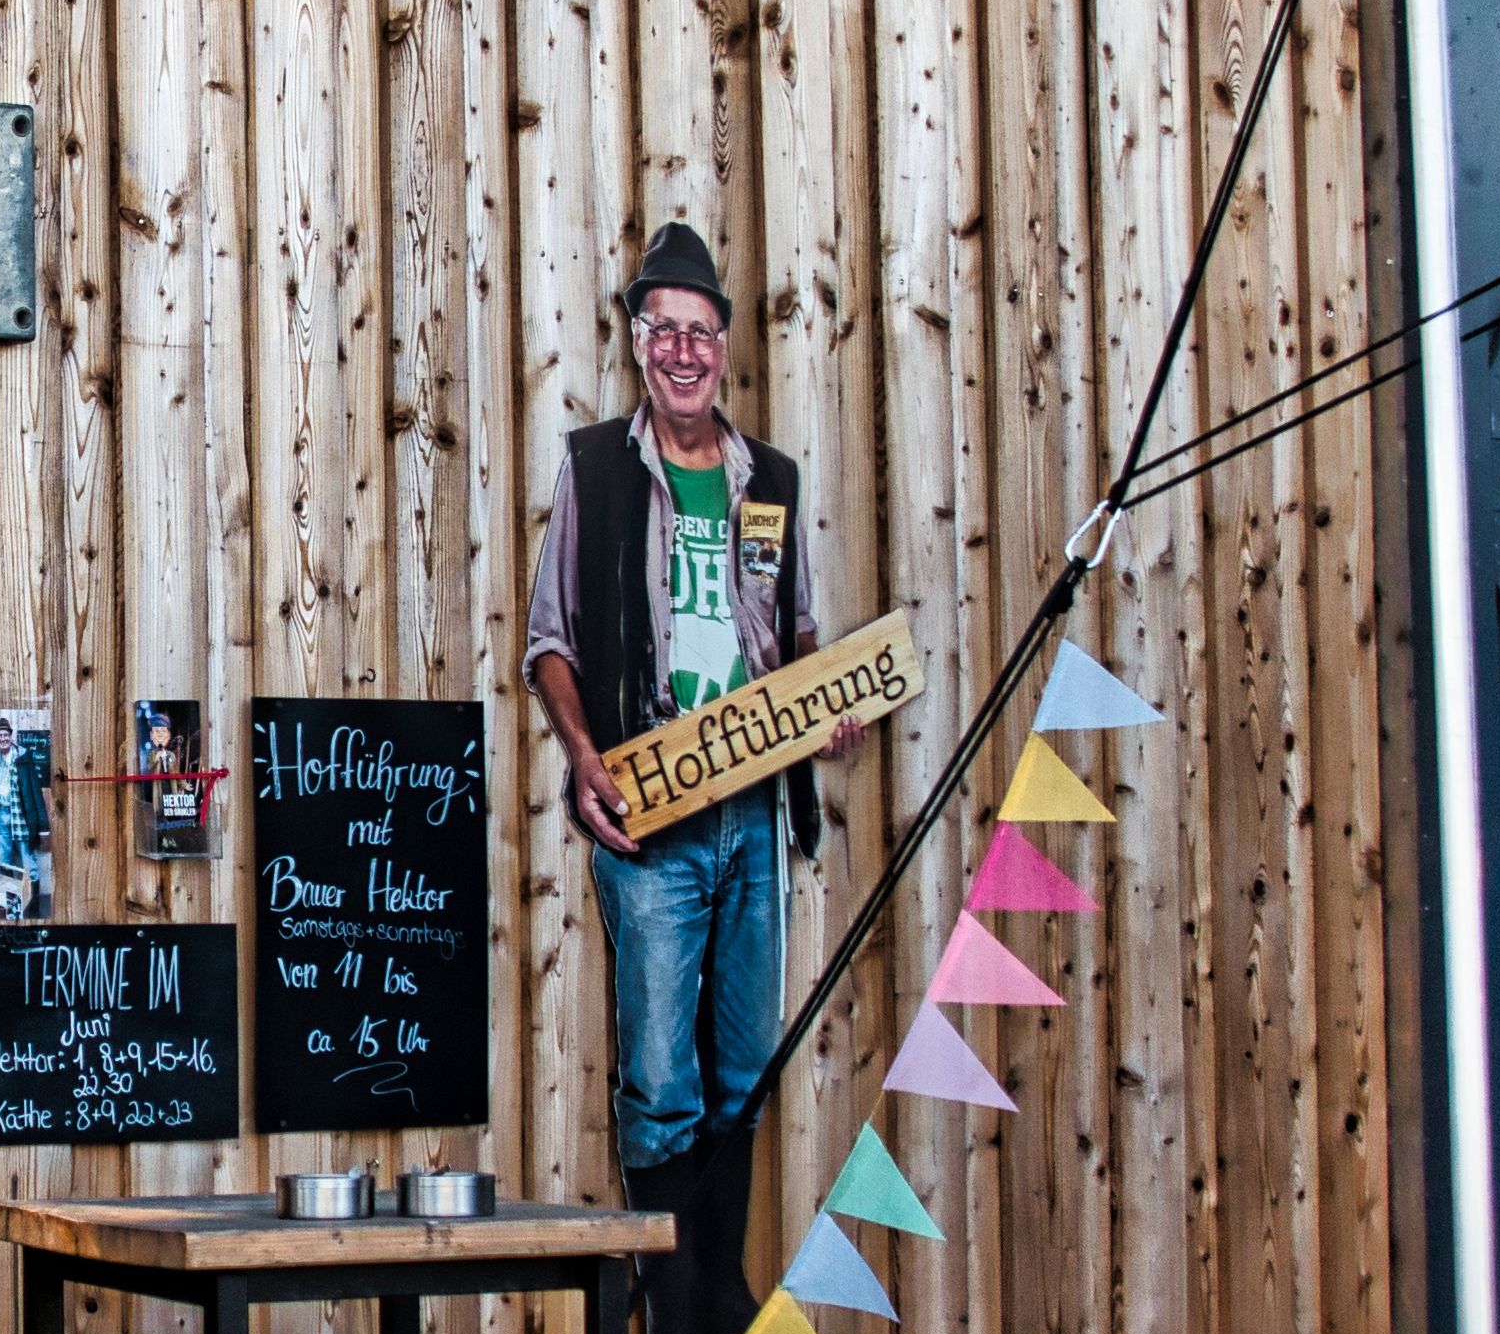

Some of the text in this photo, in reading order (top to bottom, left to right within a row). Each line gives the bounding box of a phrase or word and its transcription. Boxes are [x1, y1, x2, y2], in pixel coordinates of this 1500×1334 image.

[622, 643, 907, 814] Hofführung
[267, 720, 470, 826] Hofführung
[162, 794, 196, 808] HEKTOR
[347, 808, 393, 847] mit
[262, 855, 453, 913] Bauer Hektor
[334, 950, 364, 988] 11
[384, 957, 419, 996] bis
[60, 1010, 111, 1046] Juni
[307, 1015, 431, 1058] ca. 15 Uhr
